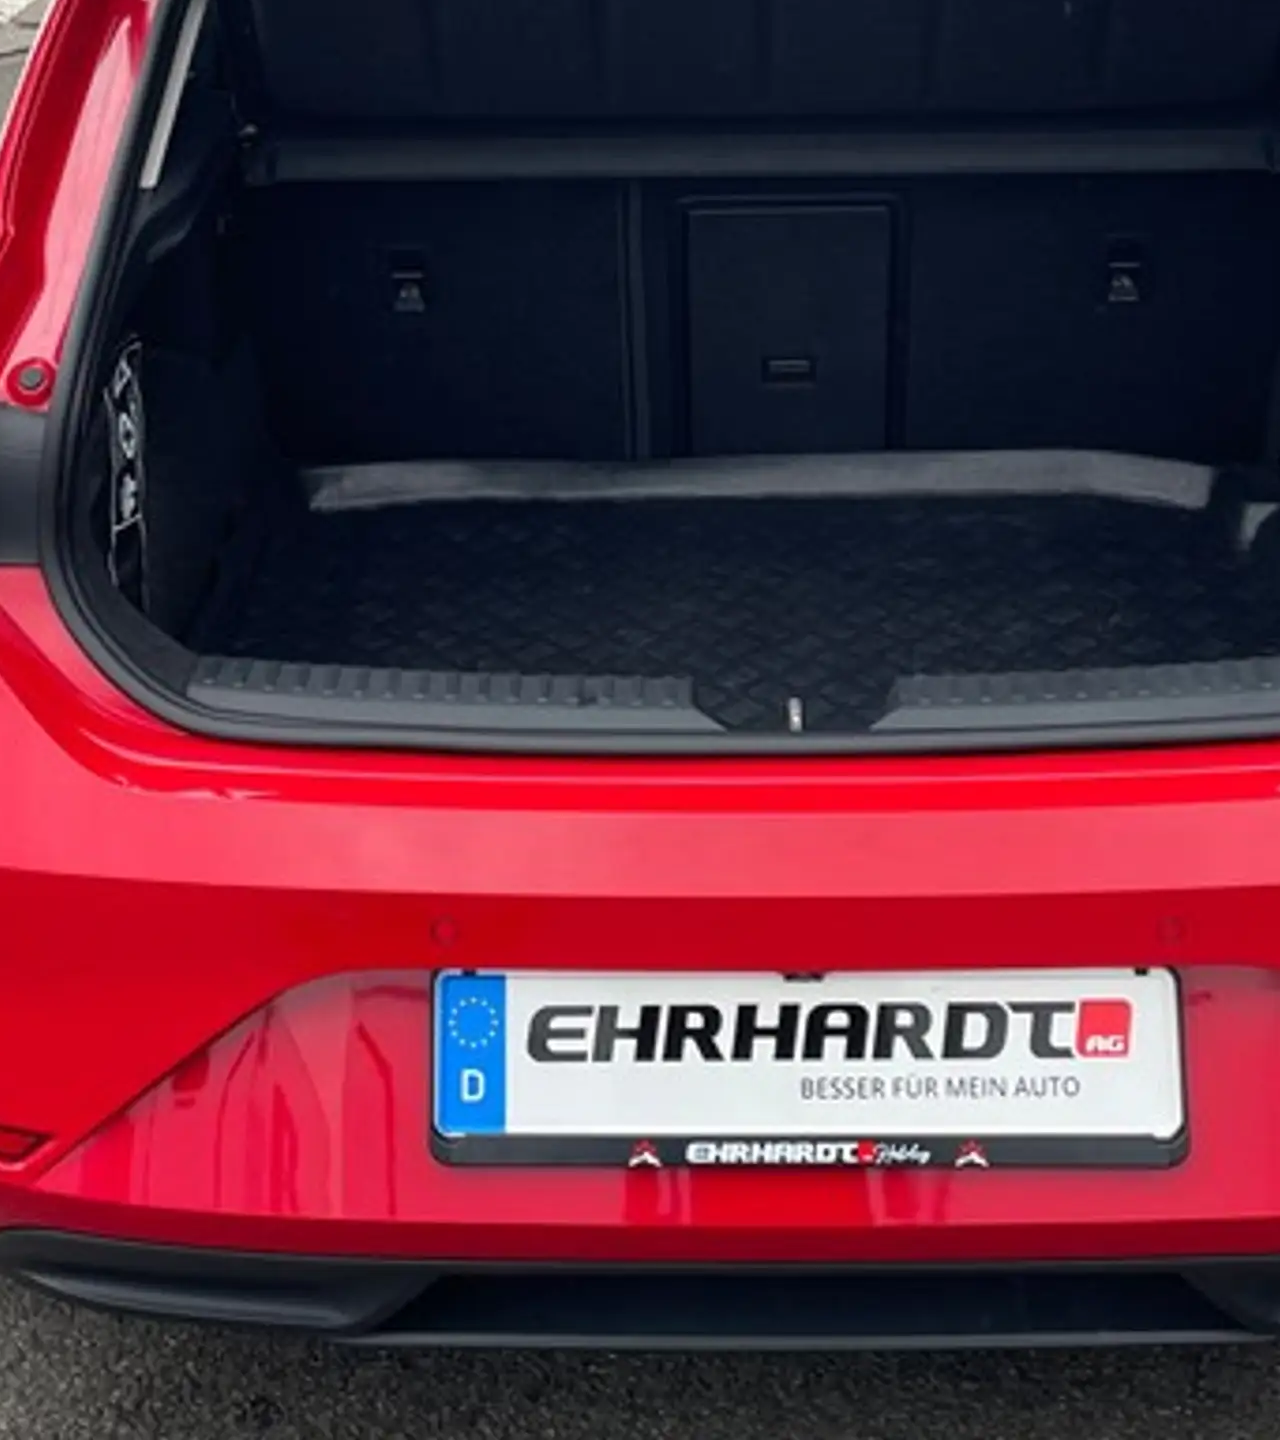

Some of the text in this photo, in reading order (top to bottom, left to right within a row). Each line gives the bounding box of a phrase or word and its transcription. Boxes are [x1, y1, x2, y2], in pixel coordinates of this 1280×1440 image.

[526, 1001, 1125, 1062] EHRHARDT AG
[460, 1068, 486, 1103] D
[801, 1072, 1081, 1100] BESSER FÜR MEIN AUTO
[686, 1142, 858, 1164] EHRHARDT
